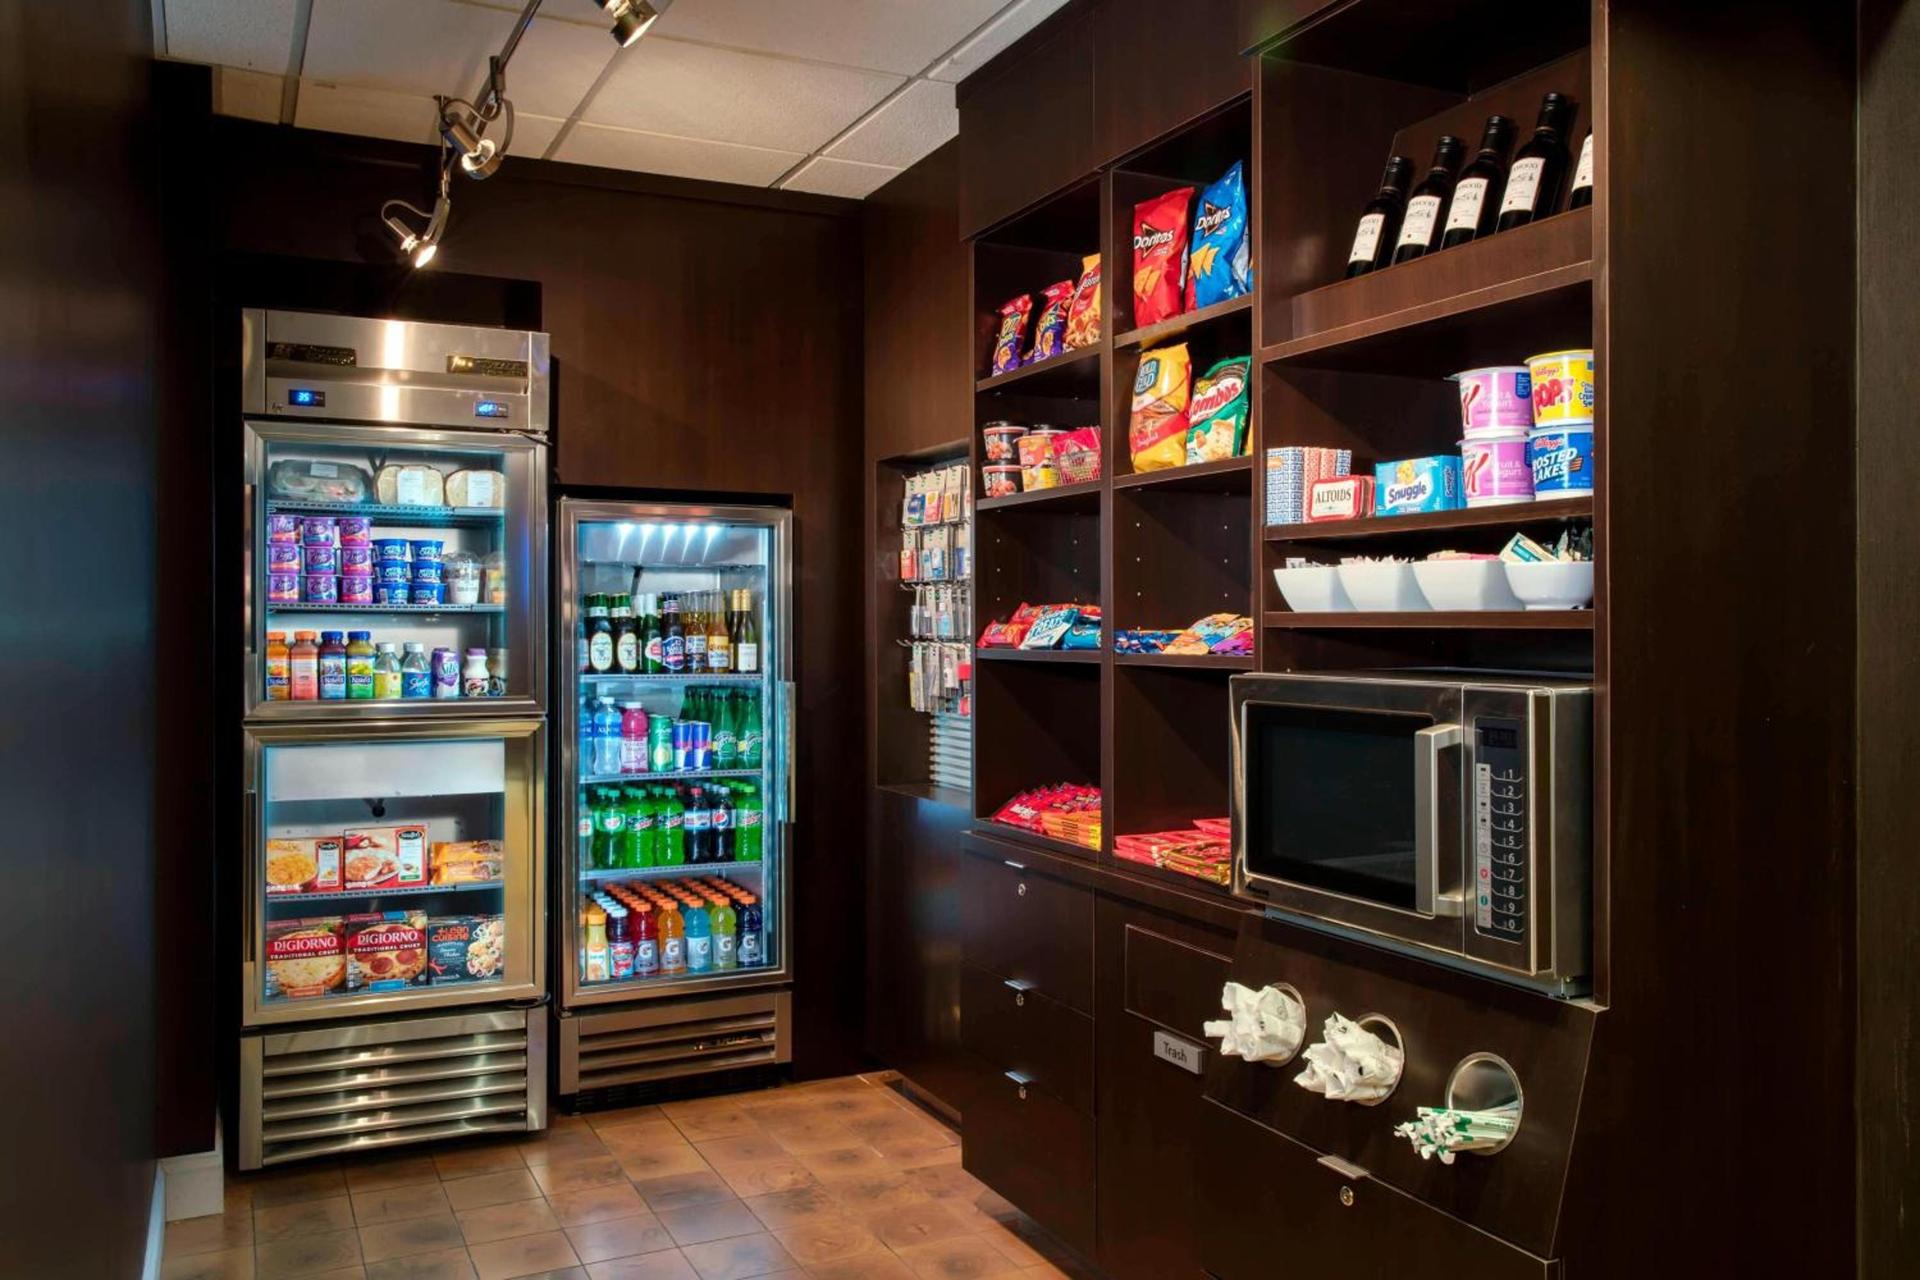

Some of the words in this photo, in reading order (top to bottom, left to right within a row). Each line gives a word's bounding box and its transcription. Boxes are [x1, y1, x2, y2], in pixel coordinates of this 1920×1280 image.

[1196, 206, 1232, 231] Doritos
[1134, 230, 1175, 250] Doritos
[1315, 487, 1353, 504] ALTOIDS
[1389, 481, 1427, 503] Snuggle
[1508, 769, 1515, 779] 1
[1508, 785, 1515, 796] 2
[1508, 803, 1515, 813] 3
[1508, 819, 1515, 829] 4
[1508, 836, 1515, 846] 5
[1508, 853, 1515, 864] 6
[1508, 869, 1515, 879] 7
[1508, 886, 1515, 896] 8
[1508, 903, 1515, 912] 9
[1508, 919, 1515, 930] 0
[270, 952, 317, 960] TRADITIONAL
[1162, 1041, 1188, 1063] Trash
